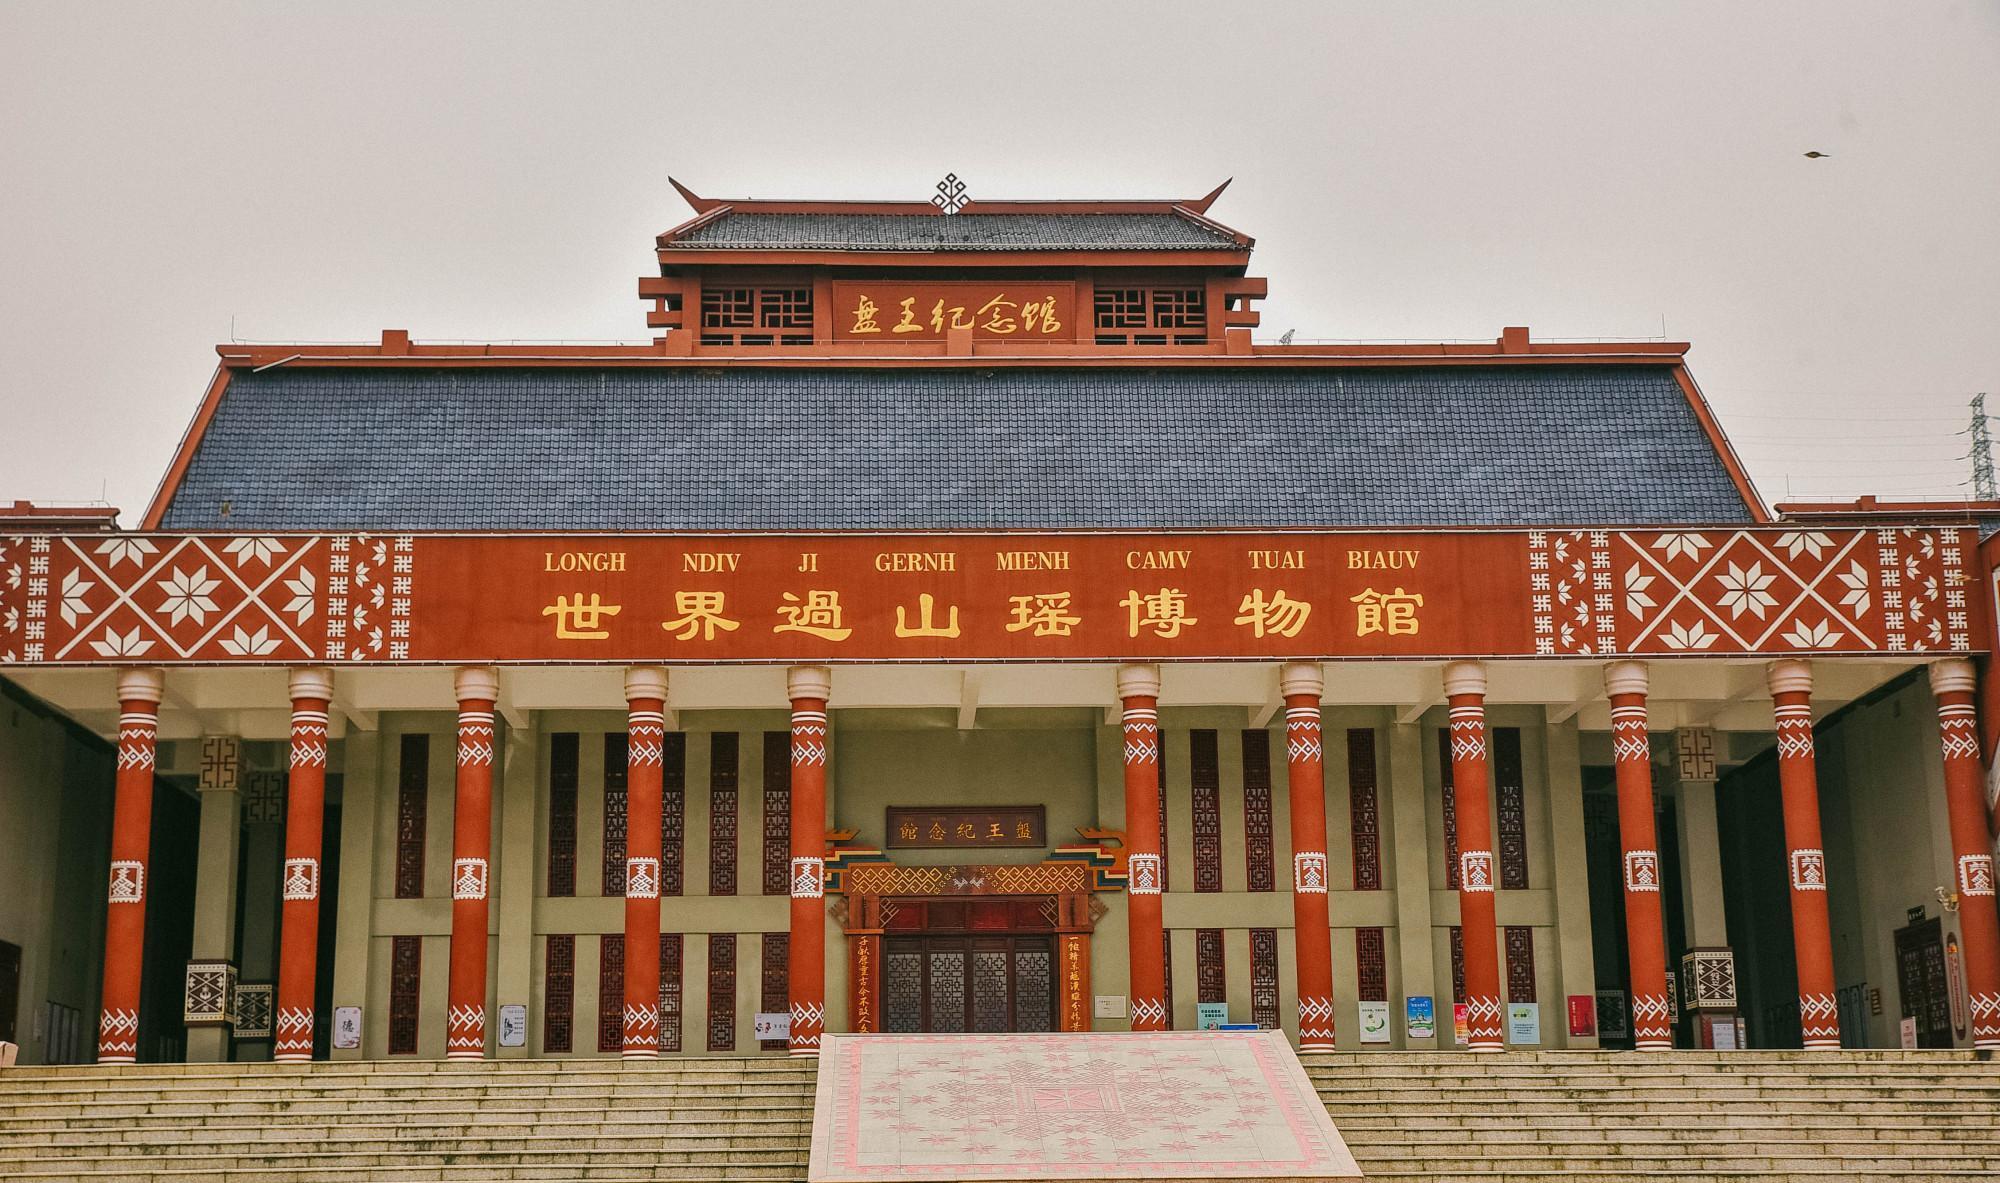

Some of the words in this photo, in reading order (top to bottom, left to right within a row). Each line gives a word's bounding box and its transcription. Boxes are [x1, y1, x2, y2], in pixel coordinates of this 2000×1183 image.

[849, 293, 1061, 334] 盘王纪念馆
[545, 552, 626, 572] LONGH
[683, 553, 741, 573] NDIV
[798, 553, 818, 573] JI
[875, 552, 956, 572] GERNH
[996, 551, 1070, 571] MIENH
[1126, 550, 1192, 570] CAMV
[1248, 550, 1305, 569] TUAI
[1347, 550, 1420, 570] BIAUV
